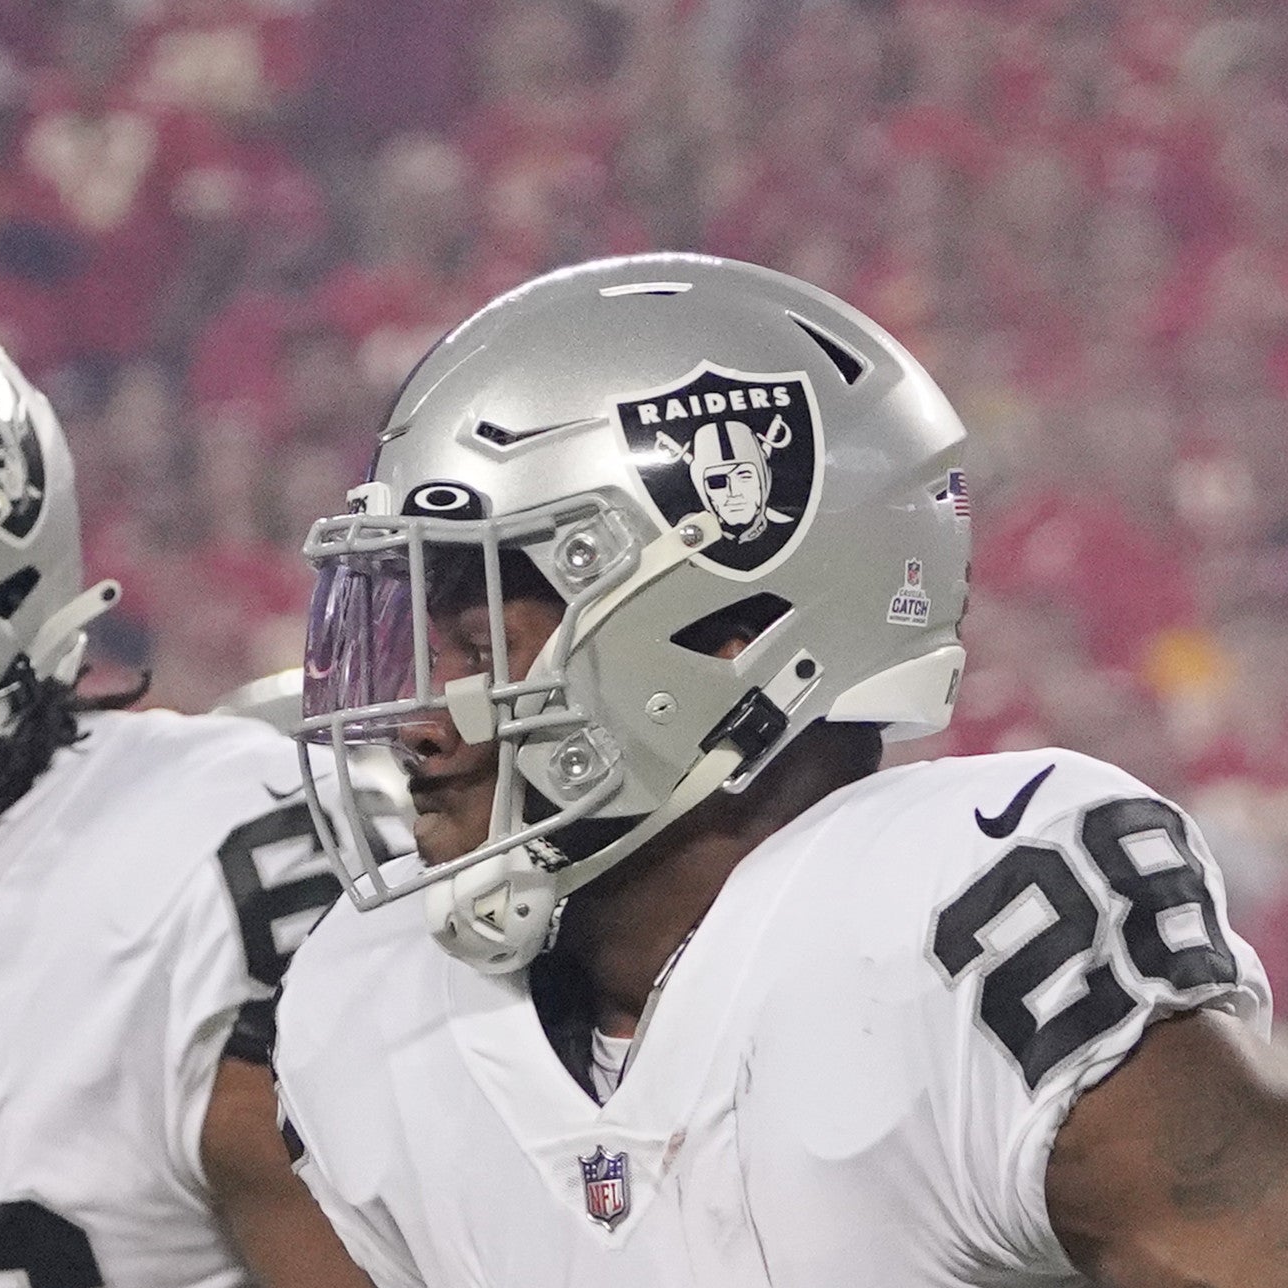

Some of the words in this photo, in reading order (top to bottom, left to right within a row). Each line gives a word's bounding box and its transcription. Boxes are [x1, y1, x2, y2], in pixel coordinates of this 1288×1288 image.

[636, 385, 792, 426] RAIDERS
[891, 597, 928, 617] CATCH
[926, 792, 1240, 1098] 28
